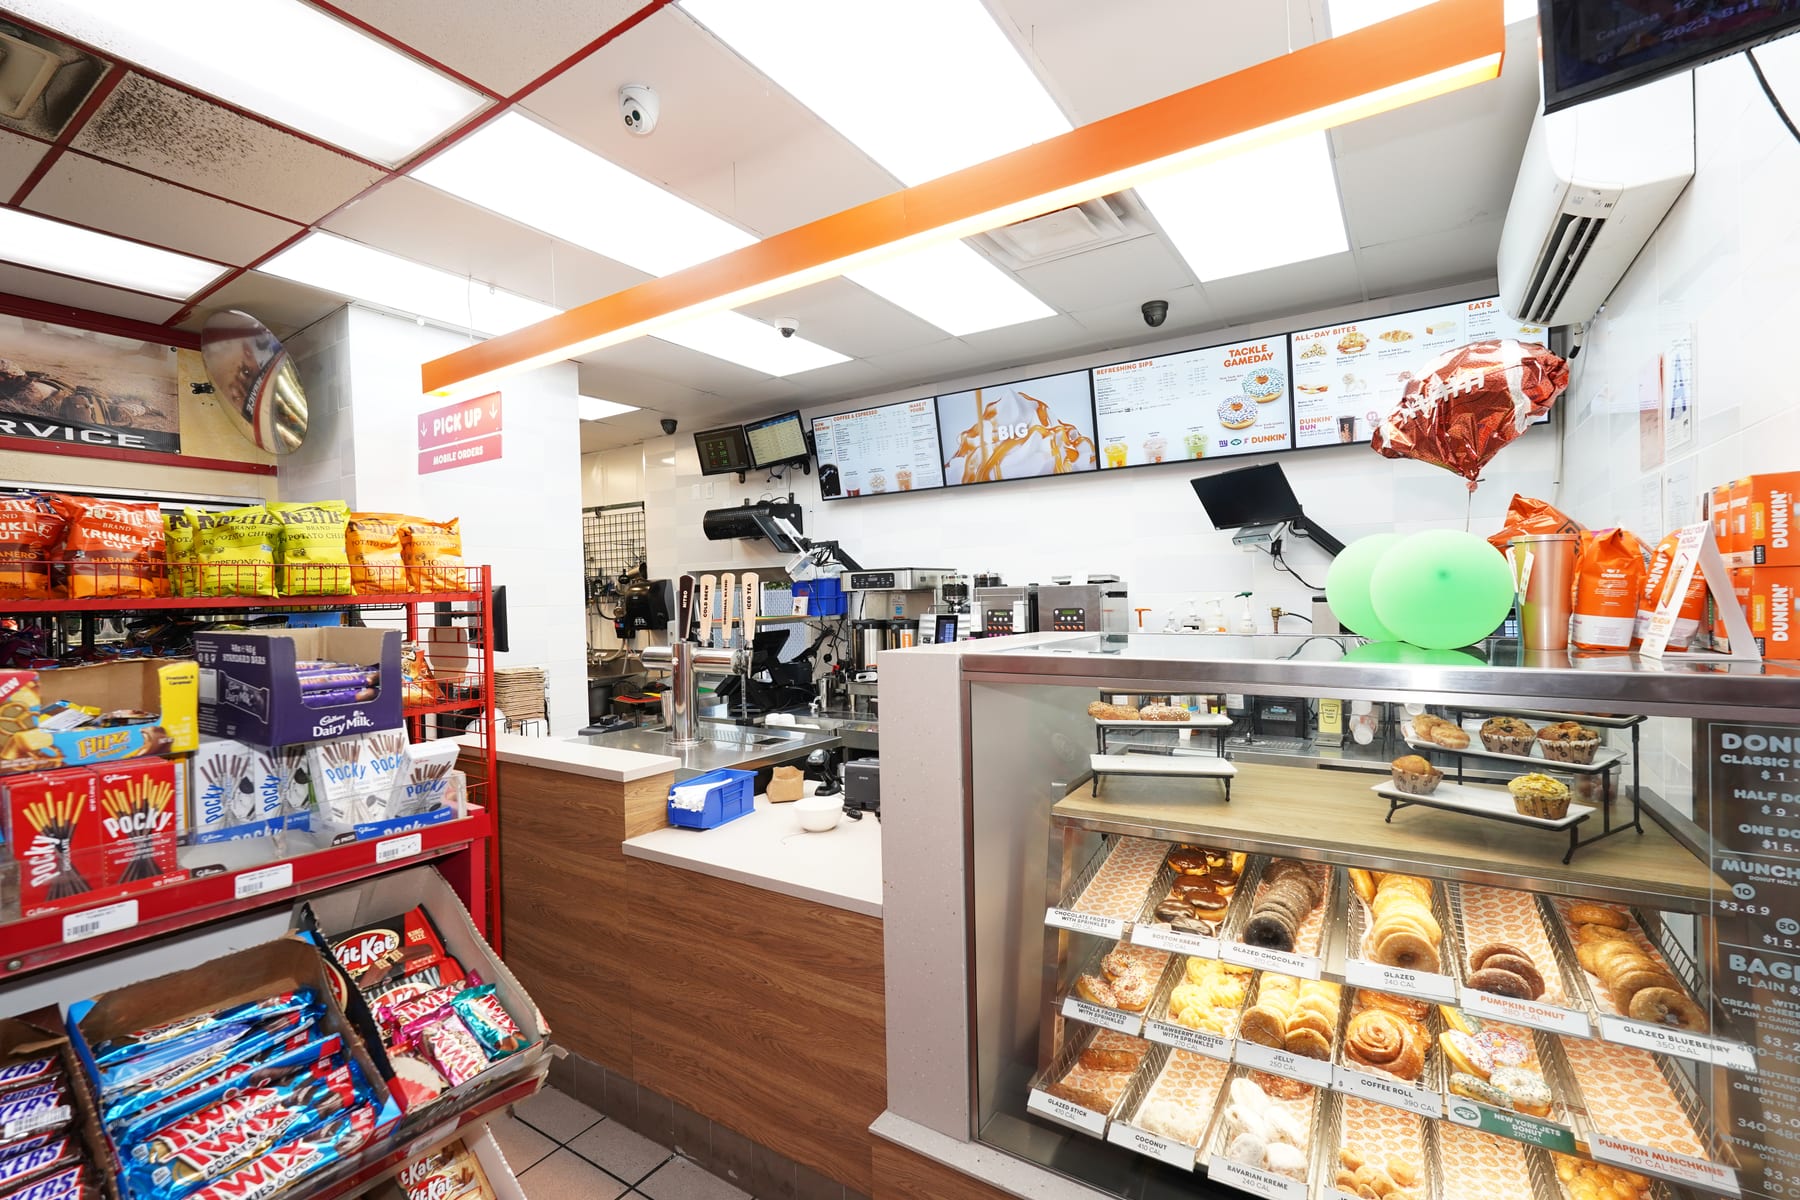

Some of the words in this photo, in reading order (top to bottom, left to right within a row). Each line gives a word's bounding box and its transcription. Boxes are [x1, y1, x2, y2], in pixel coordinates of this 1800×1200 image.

[1661, 15, 1711, 42] 2023
[1468, 300, 1493, 311] EATS
[1295, 329, 1331, 342] ALL-DAY
[1332, 325, 1357, 336] BITES
[1228, 344, 1268, 358] TACKLE
[1096, 363, 1138, 376] REFRESHING
[1138, 360, 1154, 368] SIPS
[1223, 352, 1274, 368] GAMEDAY
[433, 411, 462, 436] PICK
[464, 407, 483, 428] UP
[833, 413, 851, 422] COFFEE
[855, 409, 878, 419] ESPRESSO
[998, 422, 1029, 441] BIG
[432, 452, 457, 465] MOBILE
[457, 445, 484, 460] ORDERS
[102, 522, 132, 532] BRAND
[1770, 490, 1789, 549] DUNKIN’
[1771, 583, 1790, 642] DUNKIN’
[312, 722, 346, 737] Dairy
[76, 729, 132, 760] Flipz
[1720, 754, 1790, 768] CLASSIC
[1733, 788, 1778, 801] HALF
[1738, 823, 1775, 837] ONE
[1735, 886, 1752, 897] 10
[1054, 910, 1087, 922] CHOCOLATE
[1087, 915, 1117, 926] FROSTED
[1061, 915, 1076, 924] WITH
[1075, 917, 1109, 929] SPRINKLES
[1778, 920, 1797, 932] 50
[1152, 932, 1179, 943] BOSTON
[1179, 938, 1201, 948] KREME
[1233, 945, 1260, 958] GLAZED
[1260, 951, 1306, 969] CHOCOLATE
[1383, 971, 1416, 982] GLAZED
[1737, 975, 1786, 993] PLAIN
[1399, 980, 1418, 990] CAL
[1077, 1002, 1100, 1015] VANILLA
[1100, 1008, 1128, 1022] FROSTED
[1479, 993, 1528, 1014] PUMPKIN
[1527, 1004, 1567, 1022] DONUT
[1721, 997, 1762, 1011] CREAM
[1078, 1008, 1095, 1018] WITH
[1095, 1013, 1125, 1026] SPRINKLES
[1522, 1011, 1544, 1024] CAL
[1732, 1007, 1760, 1020] PLAIN
[1153, 1023, 1194, 1039] STRAWBERRY
[1193, 1032, 1224, 1047] FROSTED
[1162, 1031, 1179, 1042] WITH
[1178, 1035, 1215, 1050] SPRINKLES
[1623, 1024, 1667, 1042] GLAZED
[1667, 1032, 1731, 1055] BLUEBERRY
[1187, 1042, 1202, 1052] CAL
[1656, 1038, 1676, 1051] 350
[1677, 1041, 1701, 1056] CAL
[1273, 1053, 1296, 1065] JELLY
[1726, 1061, 1759, 1073] WITH
[1283, 1063, 1298, 1073] CAL
[1744, 1073, 1772, 1085] WITH
[1360, 1078, 1392, 1093] COFFEE
[1392, 1087, 1414, 1098] ROLL
[1733, 1081, 1751, 1093] OR
[1752, 1086, 1798, 1103] BUTTER
[1047, 1097, 1069, 1112] GLAZED
[1069, 1105, 1088, 1119] STICK
[1403, 1098, 1420, 1108] 390
[1420, 1103, 1437, 1113] CAL
[1065, 1111, 1078, 1121] CAL
[1493, 1112, 1513, 1124] NEW
[1515, 1118, 1539, 1131] YORK
[1539, 1125, 1561, 1137] JETS
[1511, 1123, 1544, 1137] DONUT
[180, 1100, 291, 1167] TWIX
[1513, 1130, 1526, 1139] 270
[1527, 1134, 1543, 1144] CAL
[1720, 1133, 1751, 1148] WITH
[1135, 1134, 1168, 1151] COCONUT
[1149, 1146, 1162, 1157] CAL
[1598, 1138, 1650, 1157] PUMPKIN
[1651, 1151, 1726, 1177] MUNCHKINS
[1628, 1154, 1642, 1164] 70
[1645, 1159, 1668, 1172] CAL
[1226, 1164, 1263, 1181] BAVARIAN
[1263, 1177, 1289, 1191] KREME
[1242, 1177, 1256, 1187] 240
[1255, 1182, 1271, 1193] CAL
[1763, 1181, 1784, 1194] 80
